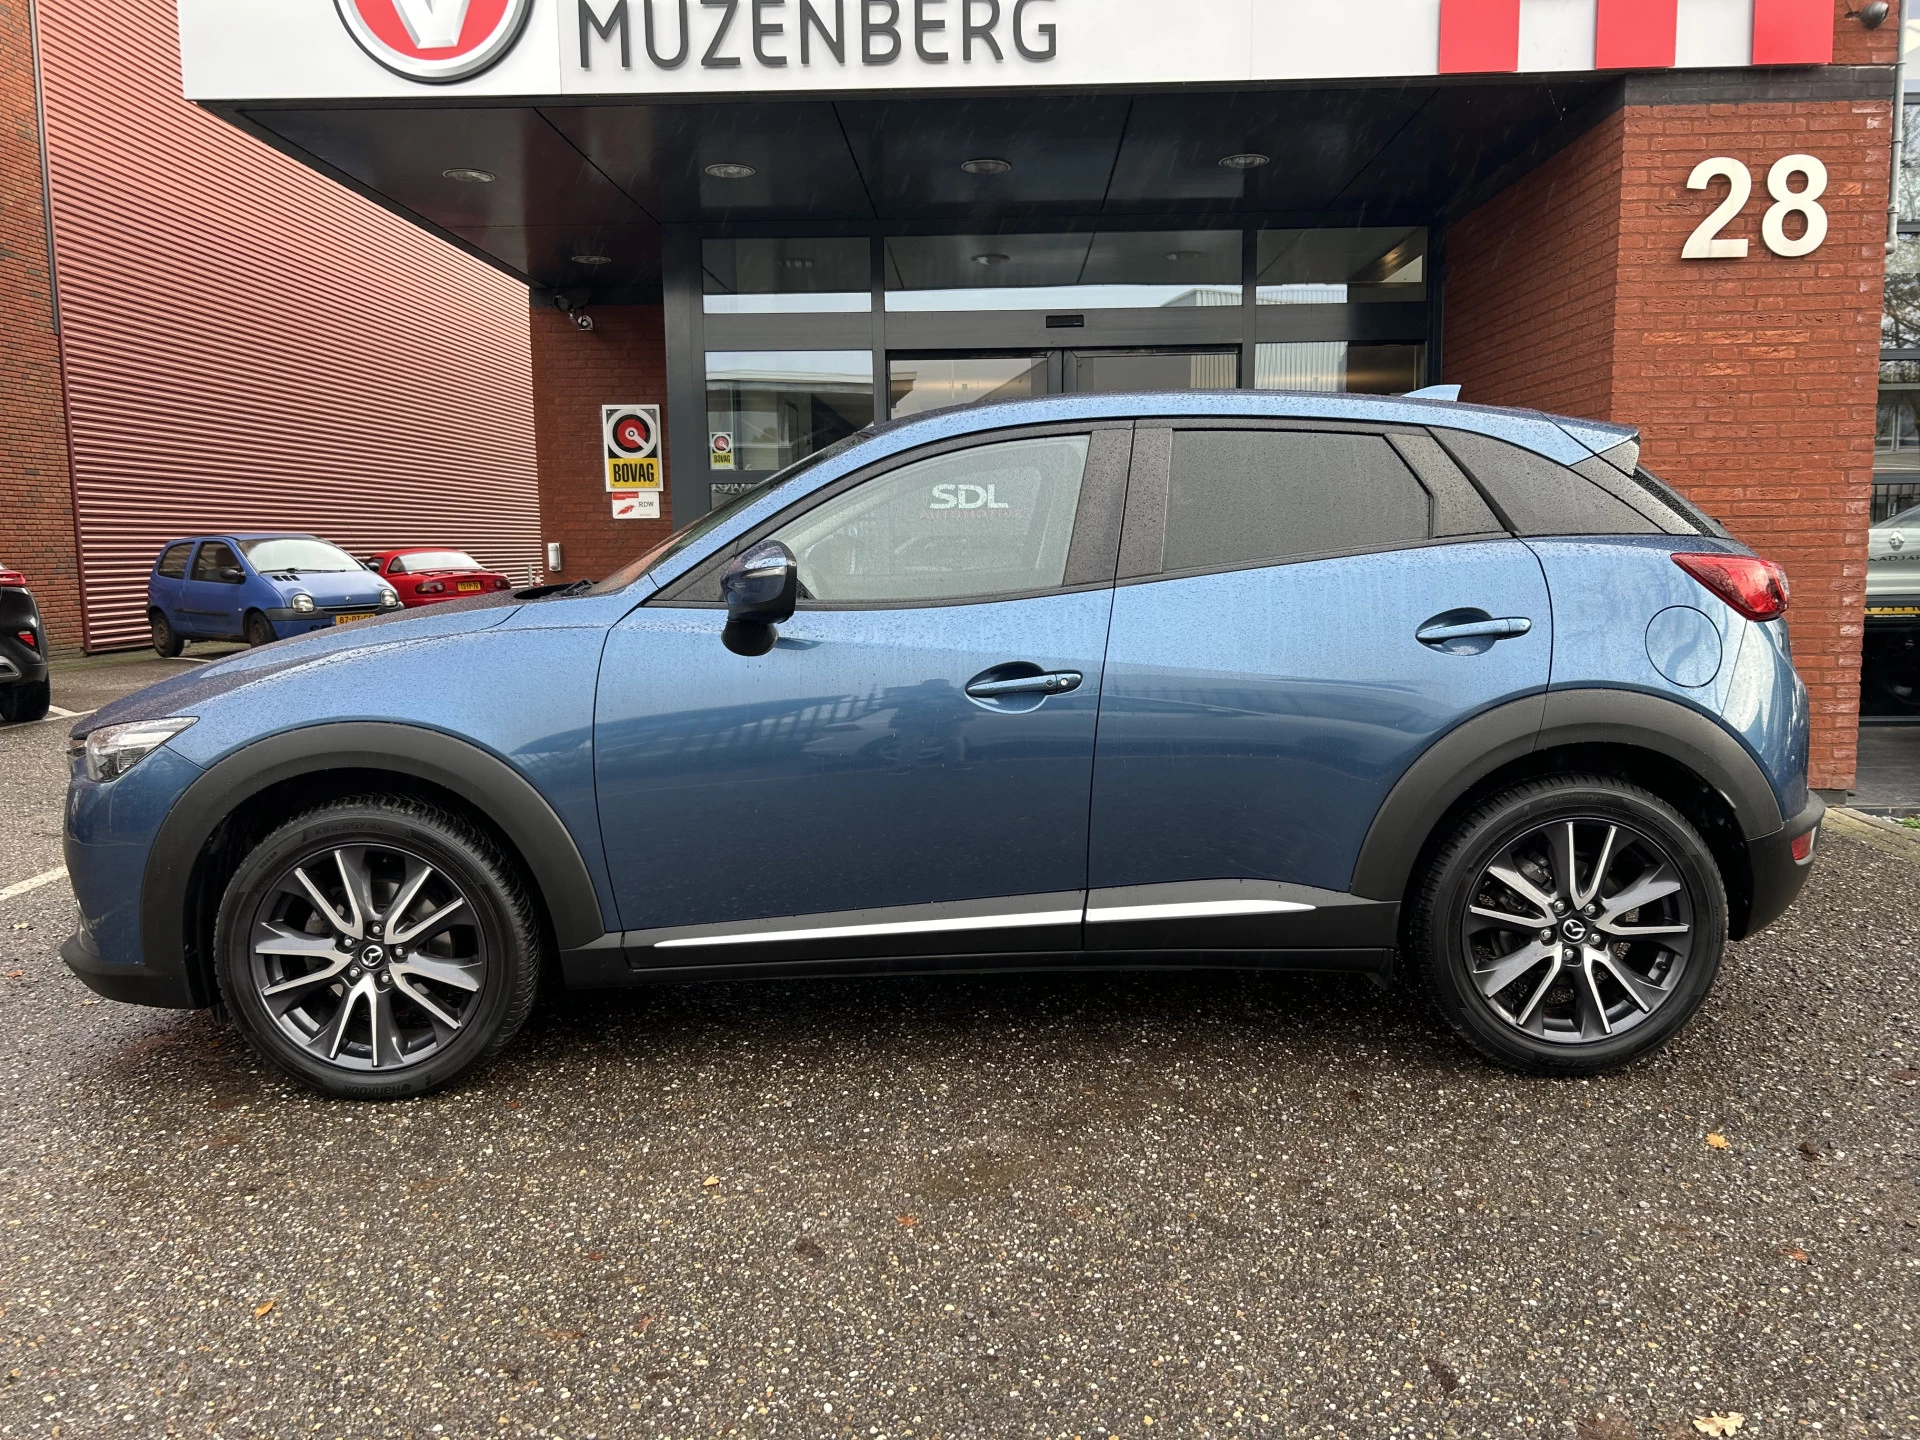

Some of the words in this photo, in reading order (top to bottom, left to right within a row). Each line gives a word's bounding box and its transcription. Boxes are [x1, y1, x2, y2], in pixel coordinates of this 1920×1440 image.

[578, 0, 1056, 68] MUZENBERG
[1681, 154, 1828, 259] 28
[713, 454, 731, 464] BOVAG
[612, 463, 655, 483] BOVAG
[930, 484, 1009, 509] SDL
[343, 1085, 401, 1096] Hankook
